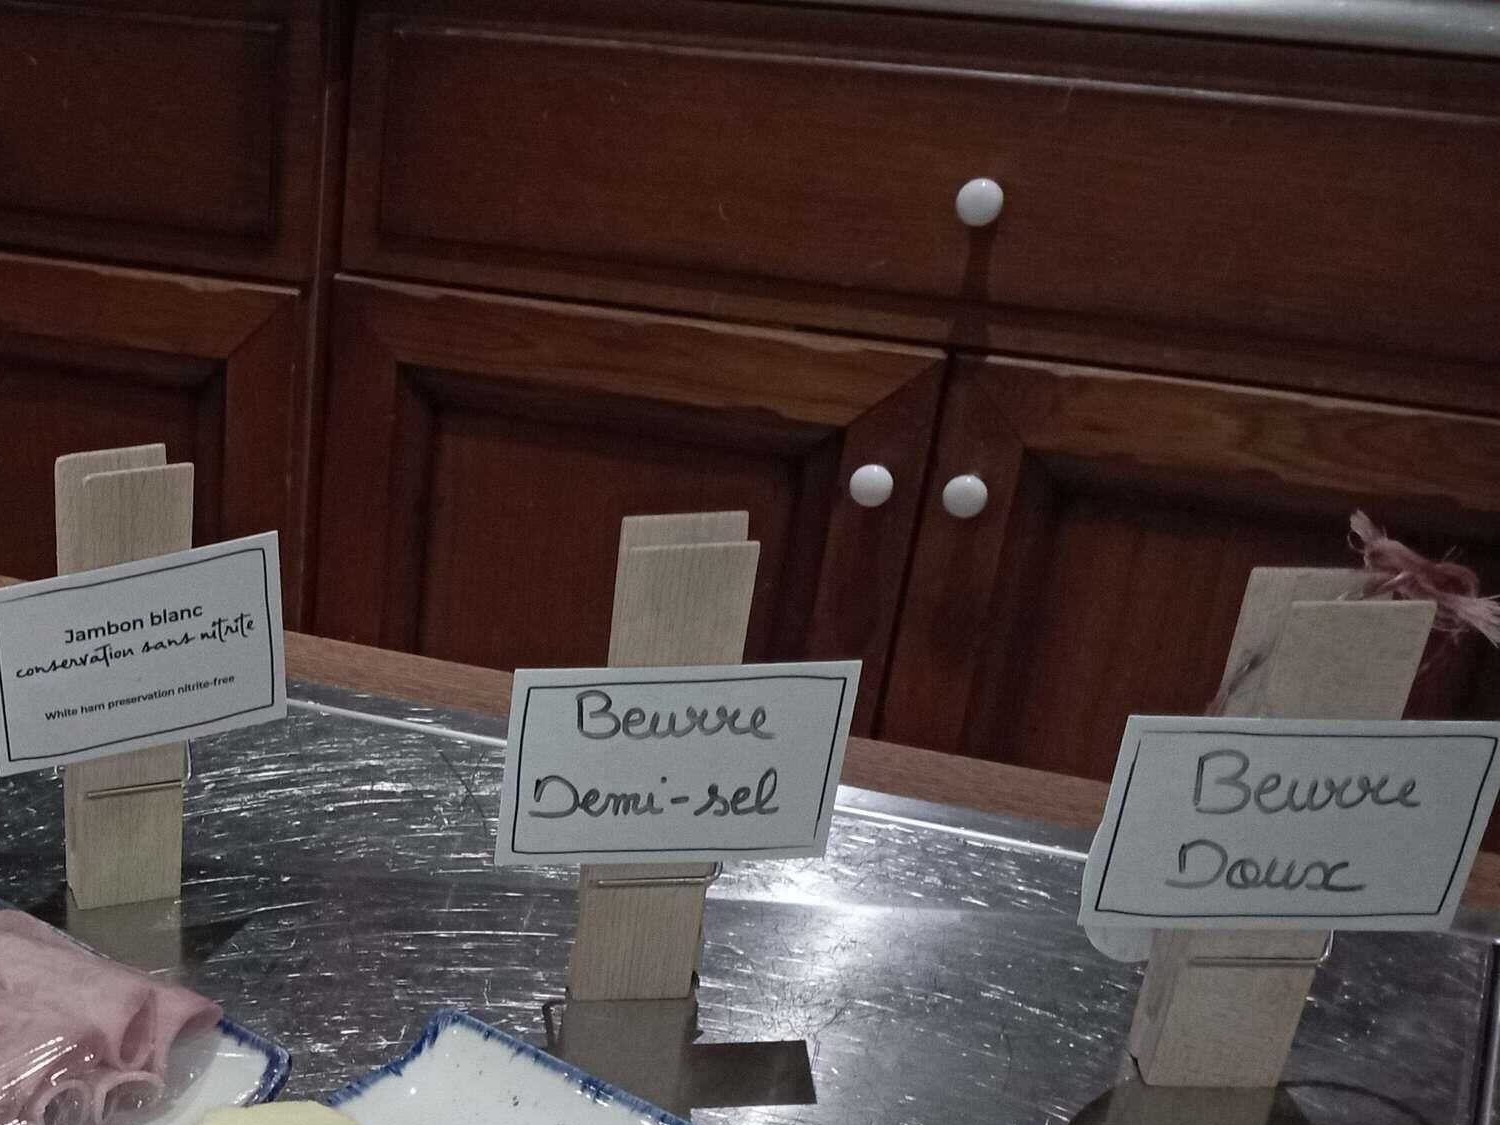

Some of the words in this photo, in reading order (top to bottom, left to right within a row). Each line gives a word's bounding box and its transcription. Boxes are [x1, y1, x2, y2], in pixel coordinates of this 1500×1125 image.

[16, 643, 134, 679] conservation
[140, 631, 196, 653] sans
[200, 613, 255, 643] nitrite
[64, 617, 144, 644] Jambon
[150, 605, 204, 627] blanc
[44, 707, 78, 721] White
[80, 702, 105, 715] ham
[107, 687, 176, 710] preservation
[177, 675, 235, 695] nitrite-free
[575, 689, 776, 739] Beurre
[528, 767, 779, 818] Demi-sel
[1193, 749, 1421, 815] Beurre
[1164, 839, 1367, 892] Doux
